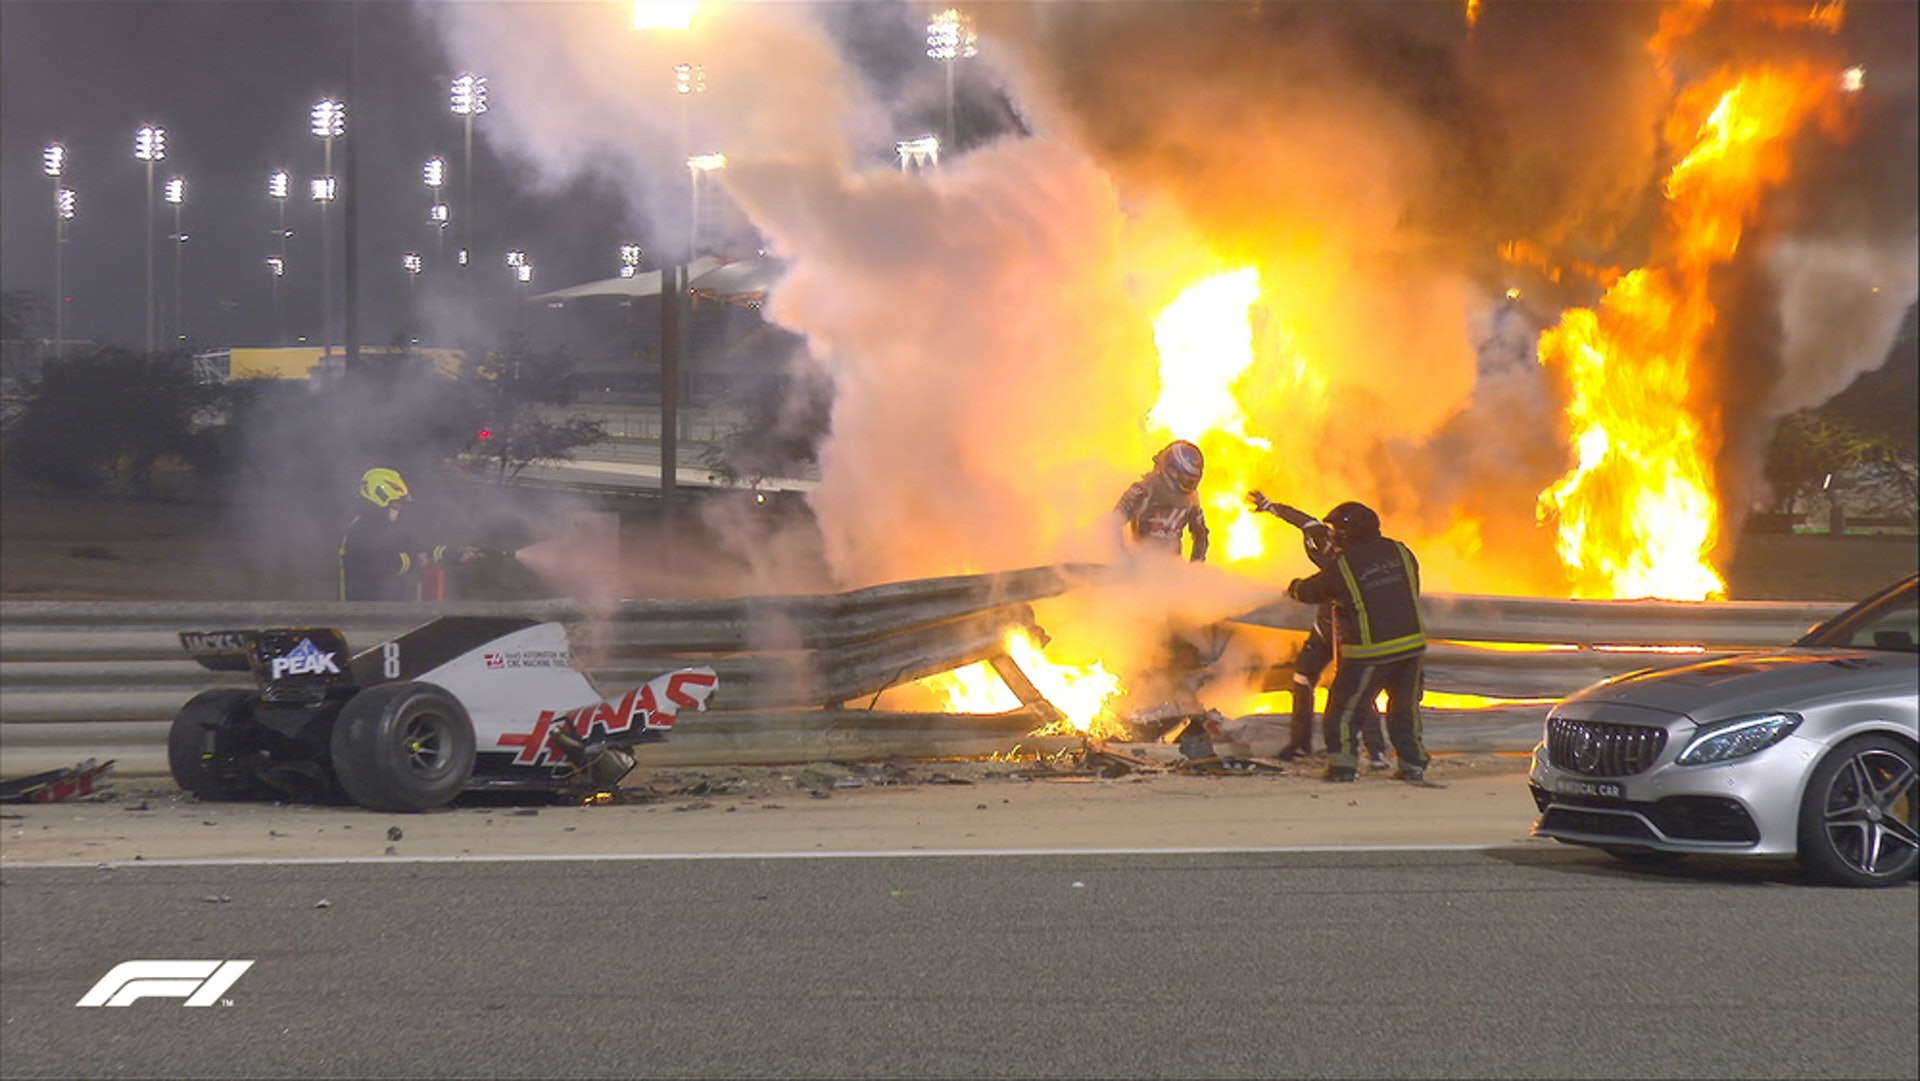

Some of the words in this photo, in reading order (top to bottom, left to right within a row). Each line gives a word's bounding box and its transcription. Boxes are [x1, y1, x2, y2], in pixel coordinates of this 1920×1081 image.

[272, 652, 341, 679] PEAK
[384, 642, 400, 679] 8
[1599, 784, 1620, 797] CAR
